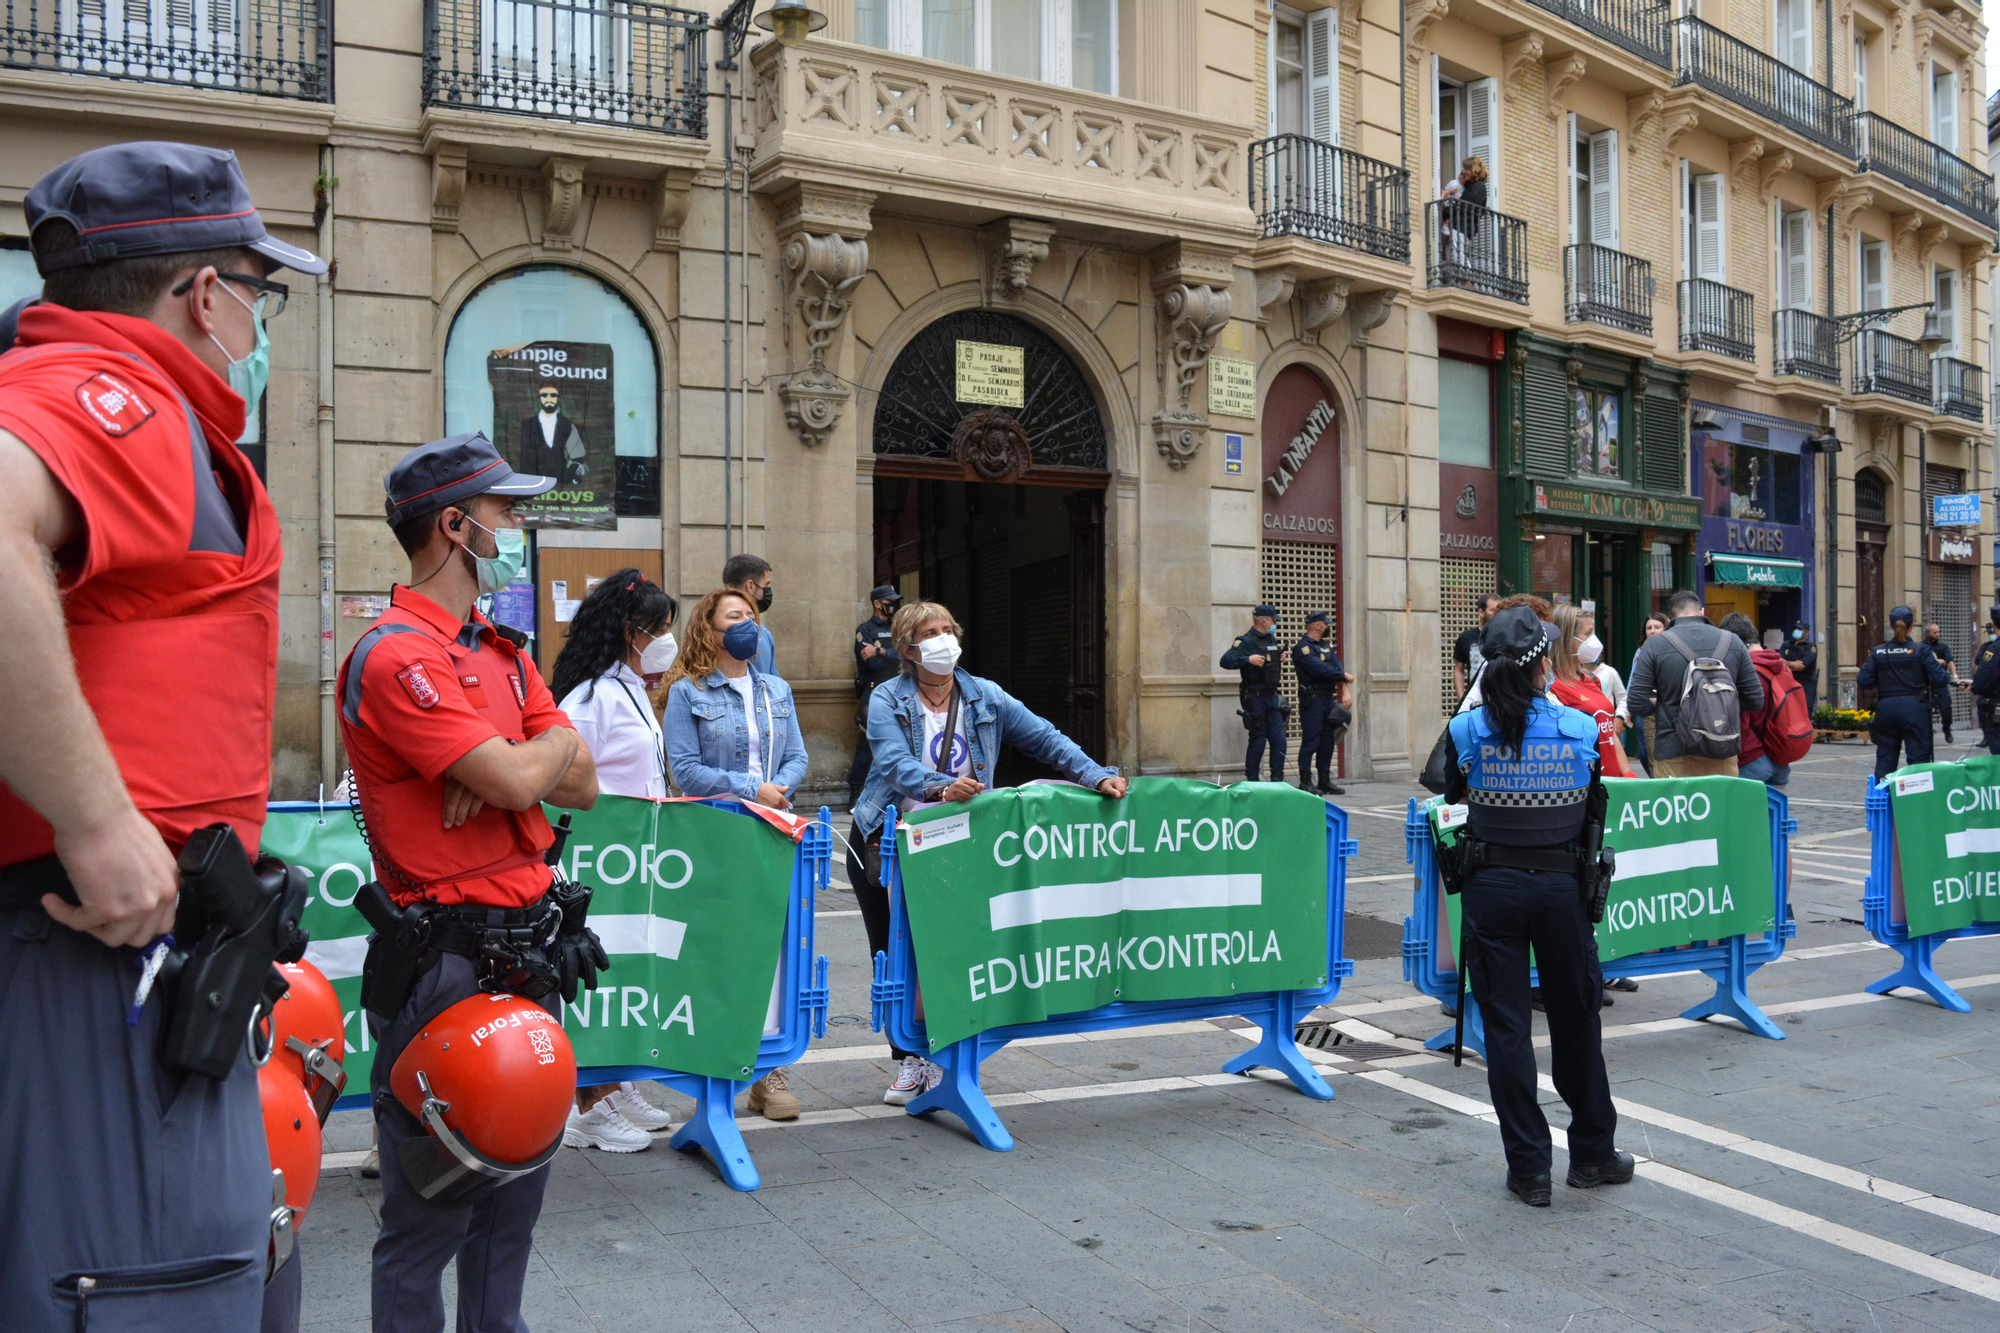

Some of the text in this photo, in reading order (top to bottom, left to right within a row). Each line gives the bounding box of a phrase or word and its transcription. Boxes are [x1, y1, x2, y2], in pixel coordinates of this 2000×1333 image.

[980, 352, 1004, 363] PASAJE
[539, 364, 607, 380] Sound
[991, 365, 1019, 375] SEMINARIO
[1227, 366, 1241, 375] CALLE
[988, 377, 1020, 387] SEMINARIO
[1227, 377, 1252, 386] SATURNINO
[972, 386, 1009, 396] PASABIDEA
[1213, 388, 1253, 400] SAN SATURNINO
[1225, 399, 1240, 408] KALEA
[1266, 400, 1335, 496] LA INFANTIL
[1552, 489, 1582, 501] HELADOS
[1550, 500, 1585, 512] REFRESCOS
[1590, 493, 1614, 516] KM
[1665, 503, 1697, 514] GOLOSINAS
[1671, 514, 1691, 523] PASTAS
[1935, 510, 1980, 521] 948 21 20 00
[1263, 513, 1334, 534] CALZADOS
[1439, 532, 1494, 550] CALZADOS
[1728, 524, 1783, 552] FLORES
[1481, 744, 1575, 761] POLICIA
[1482, 762, 1575, 774] MUNICIPAL
[1482, 776, 1575, 789] UDALTZAINGOA
[1619, 792, 1711, 831] AFORO
[994, 818, 1258, 867] CONTROL AFORO
[1607, 885, 1734, 933] KONTROLA
[470, 1013, 522, 1047] Foral
